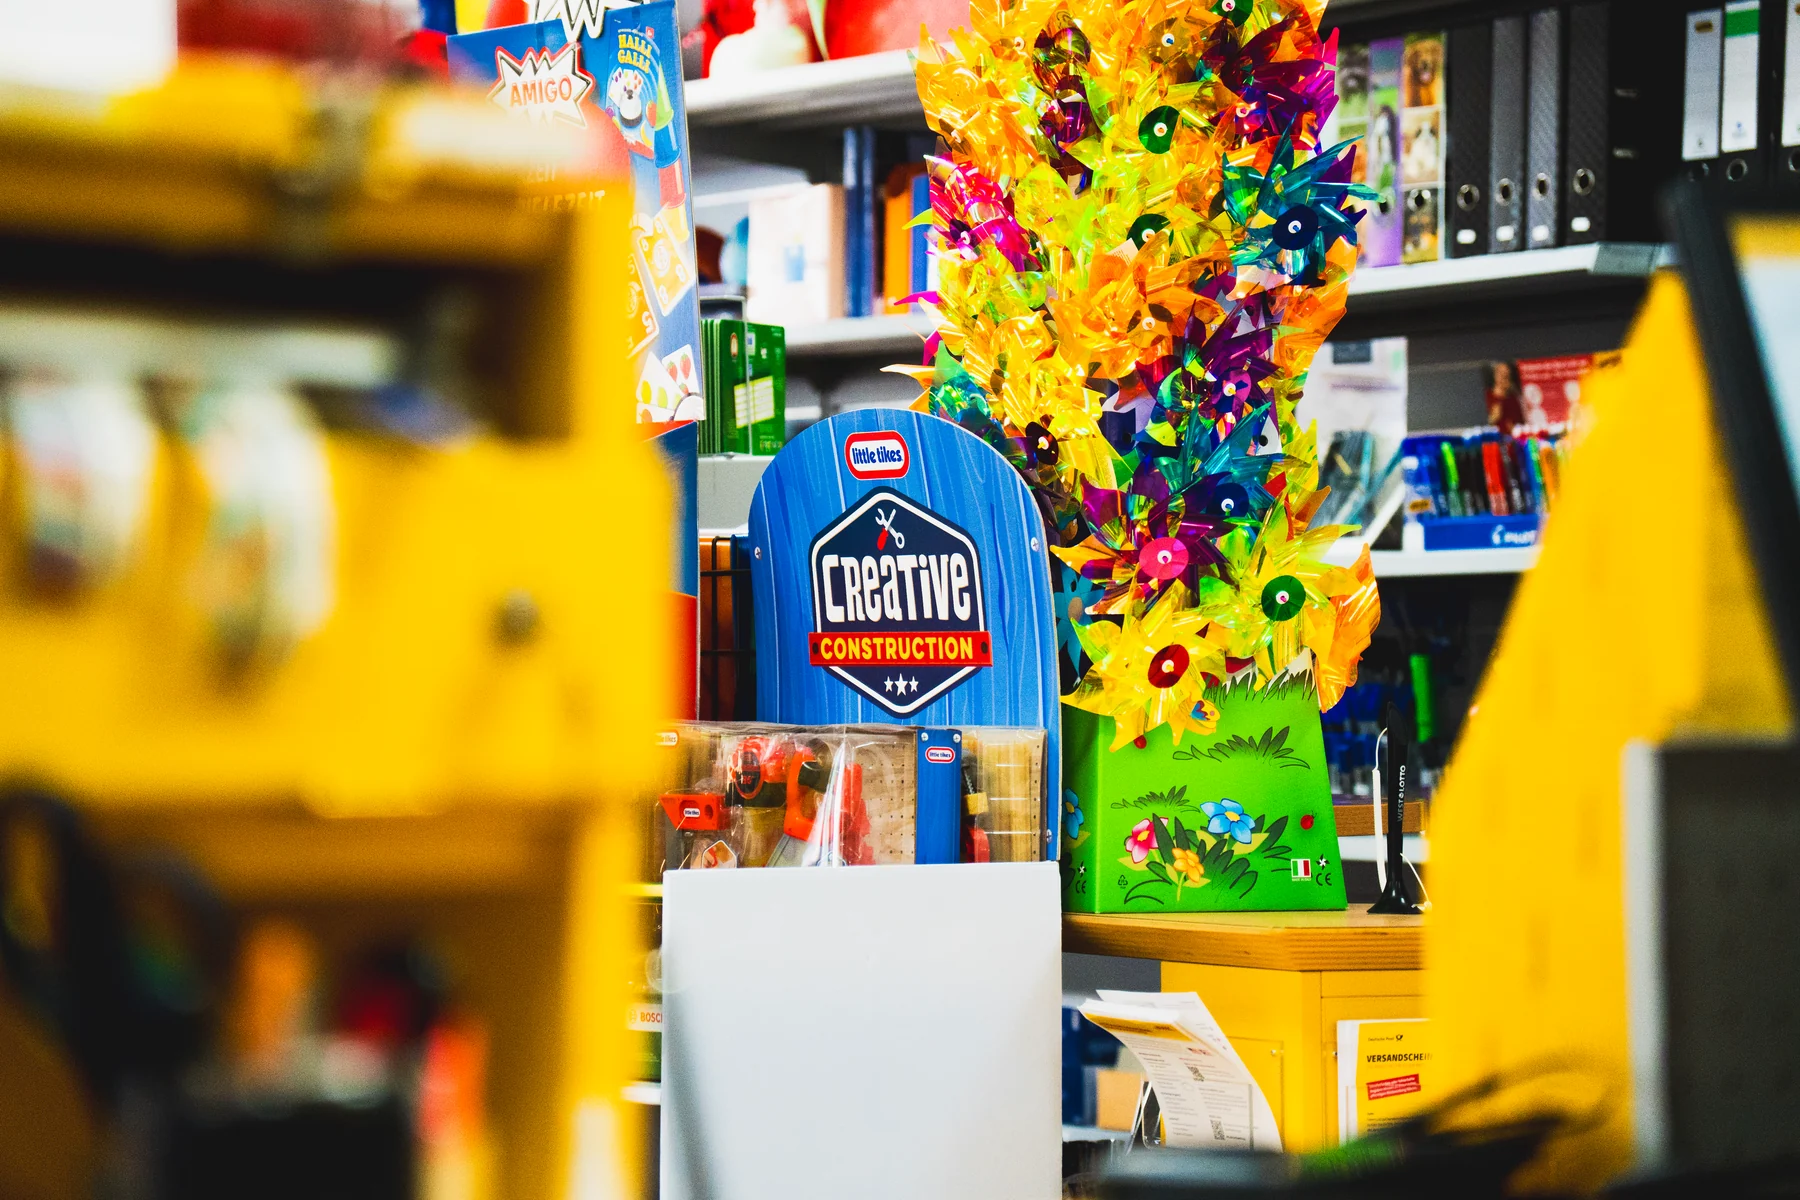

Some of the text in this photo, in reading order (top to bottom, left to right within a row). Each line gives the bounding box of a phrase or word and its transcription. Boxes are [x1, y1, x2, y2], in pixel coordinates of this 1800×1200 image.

[618, 34, 652, 58] HALLI
[617, 50, 650, 74] GALLI
[510, 75, 572, 107] AMIGO
[852, 445, 902, 464] little tikes
[820, 637, 973, 660] CONSTRUCTION
